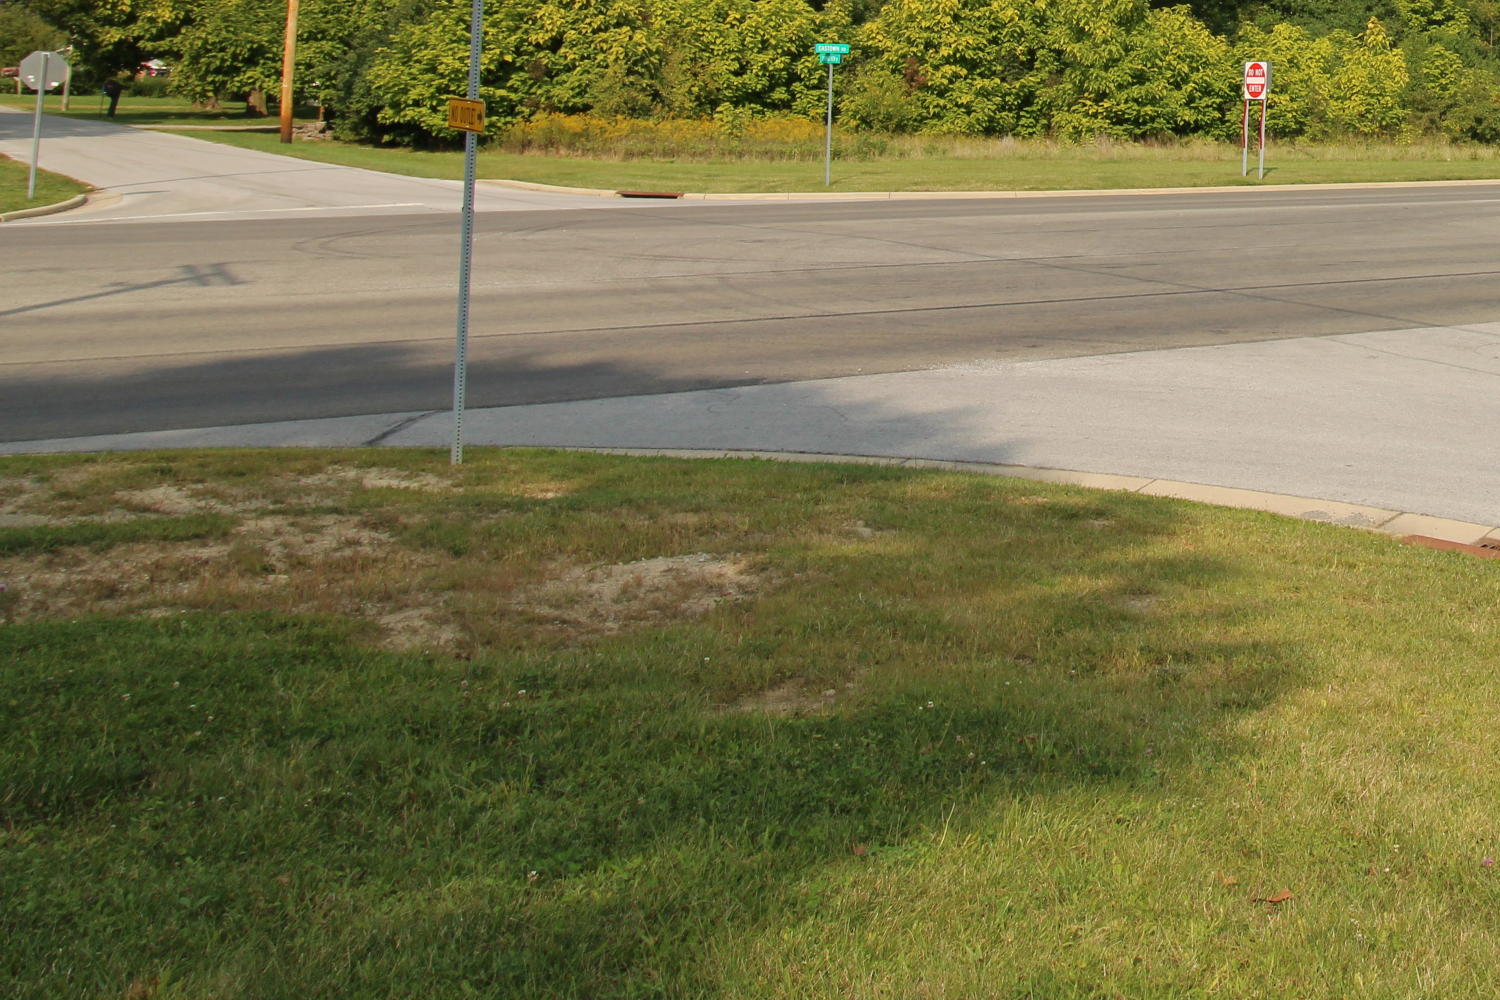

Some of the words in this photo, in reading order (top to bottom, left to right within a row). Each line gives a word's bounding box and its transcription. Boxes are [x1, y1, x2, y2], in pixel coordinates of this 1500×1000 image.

[1248, 68, 1255, 76] DO
[1255, 68, 1263, 76] NOT
[451, 104, 458, 122] NO
[460, 106, 476, 125] OUTLET
